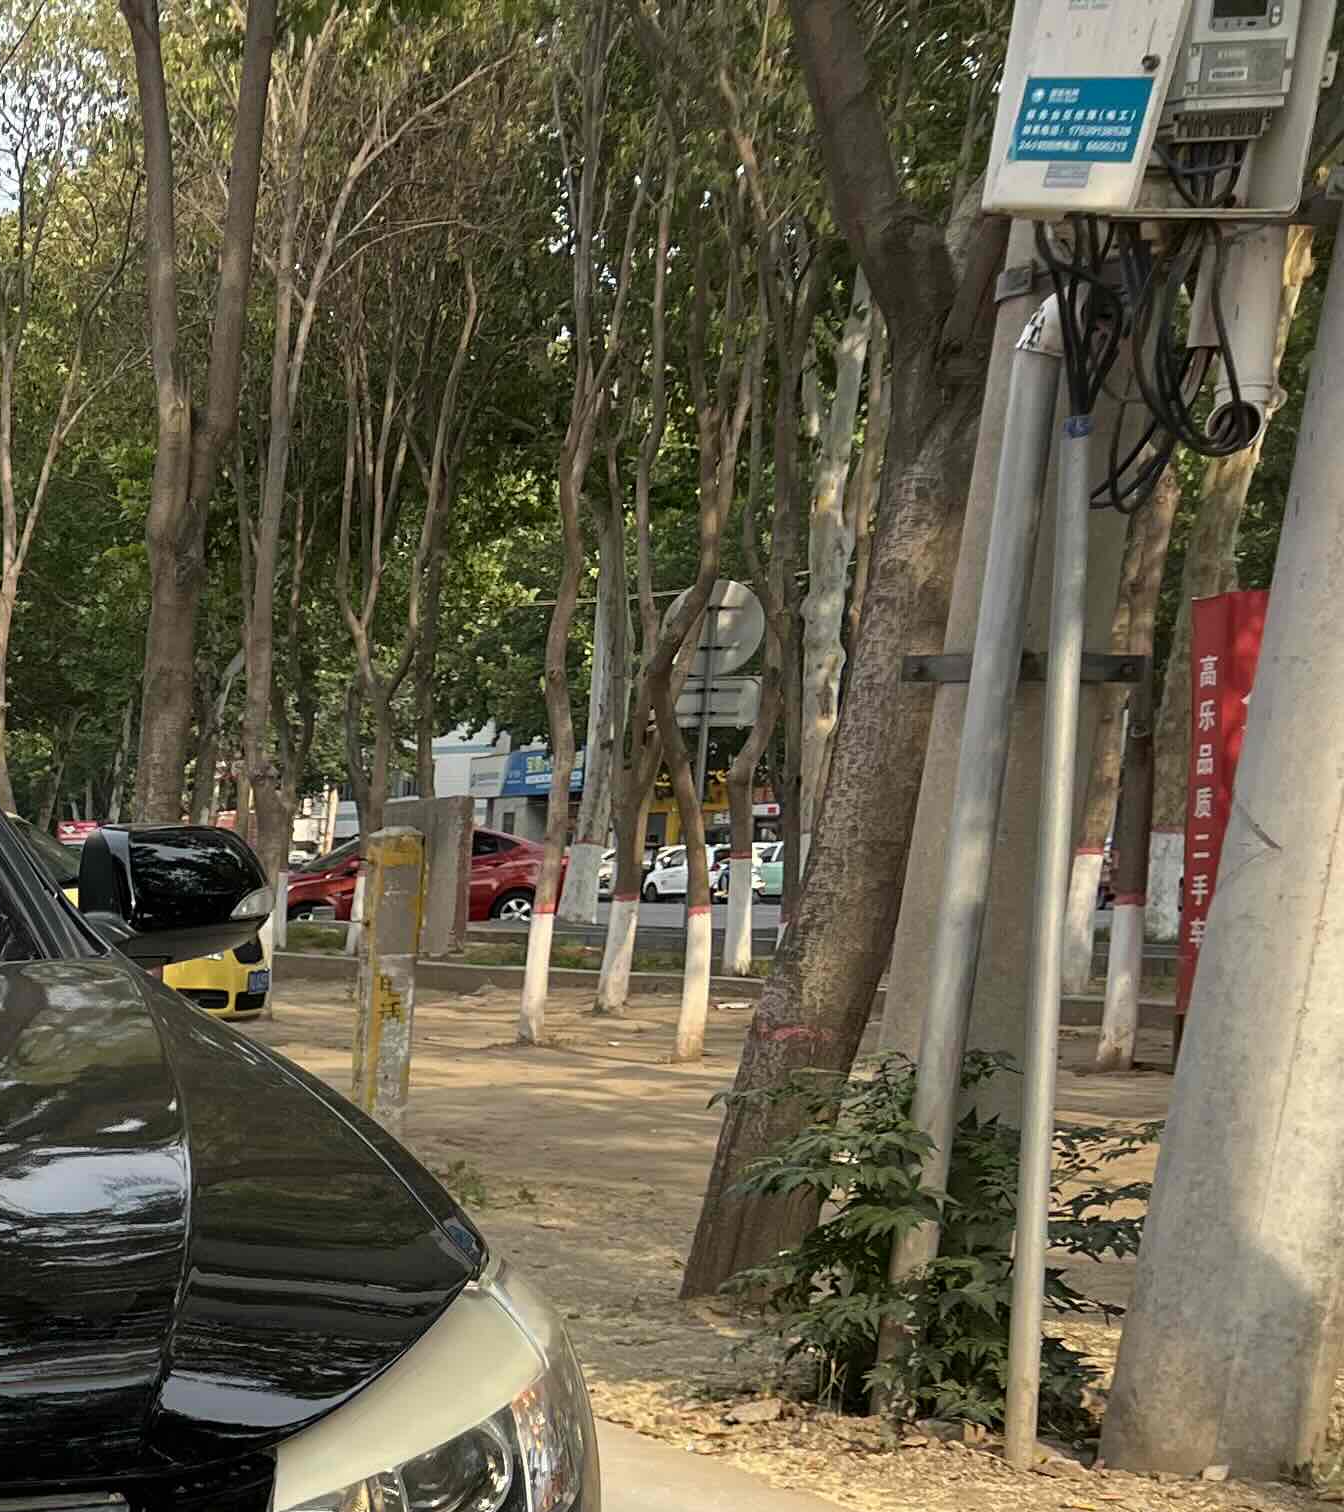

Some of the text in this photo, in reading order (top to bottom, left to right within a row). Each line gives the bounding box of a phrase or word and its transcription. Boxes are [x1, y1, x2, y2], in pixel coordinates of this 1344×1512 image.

[1187, 655, 1220, 950] 高乐品质二手车
